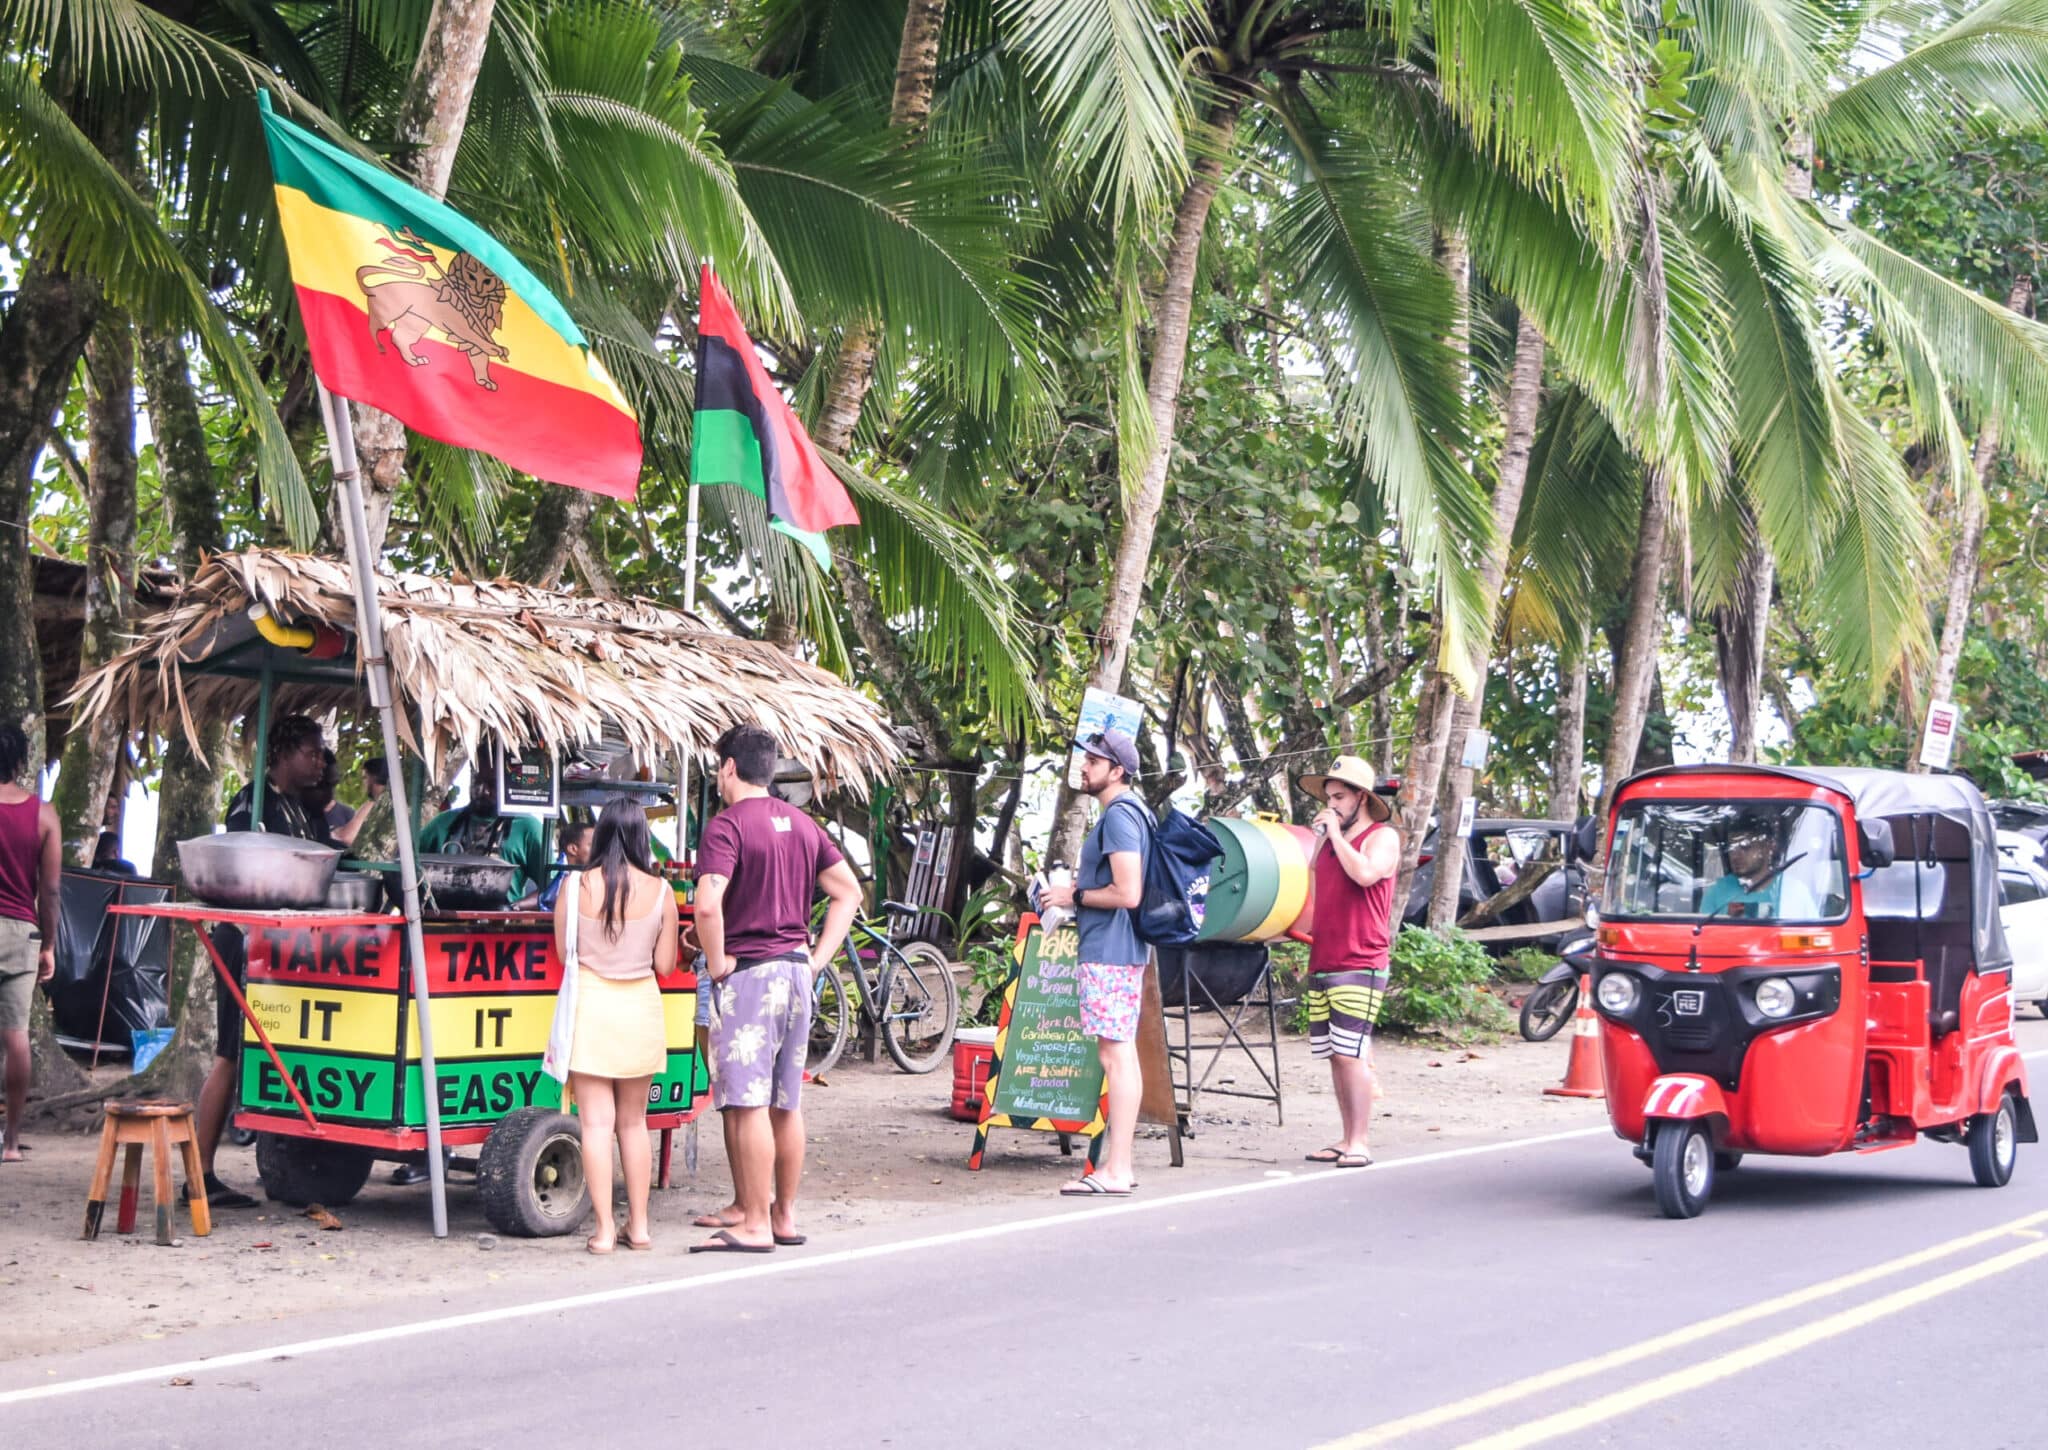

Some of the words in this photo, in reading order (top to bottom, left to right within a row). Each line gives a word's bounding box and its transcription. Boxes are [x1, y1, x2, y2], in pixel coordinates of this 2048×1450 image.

[263, 930, 381, 977] TAKE
[441, 941, 548, 982] TAKE
[252, 1000, 291, 1014] Puerto
[300, 999, 342, 1042] IT
[1679, 999, 1697, 1010] RE
[475, 1008, 512, 1048] IT
[1021, 1026, 1065, 1041] Caribbean
[259, 1061, 376, 1112] EASY
[437, 1070, 543, 1116] EASY
